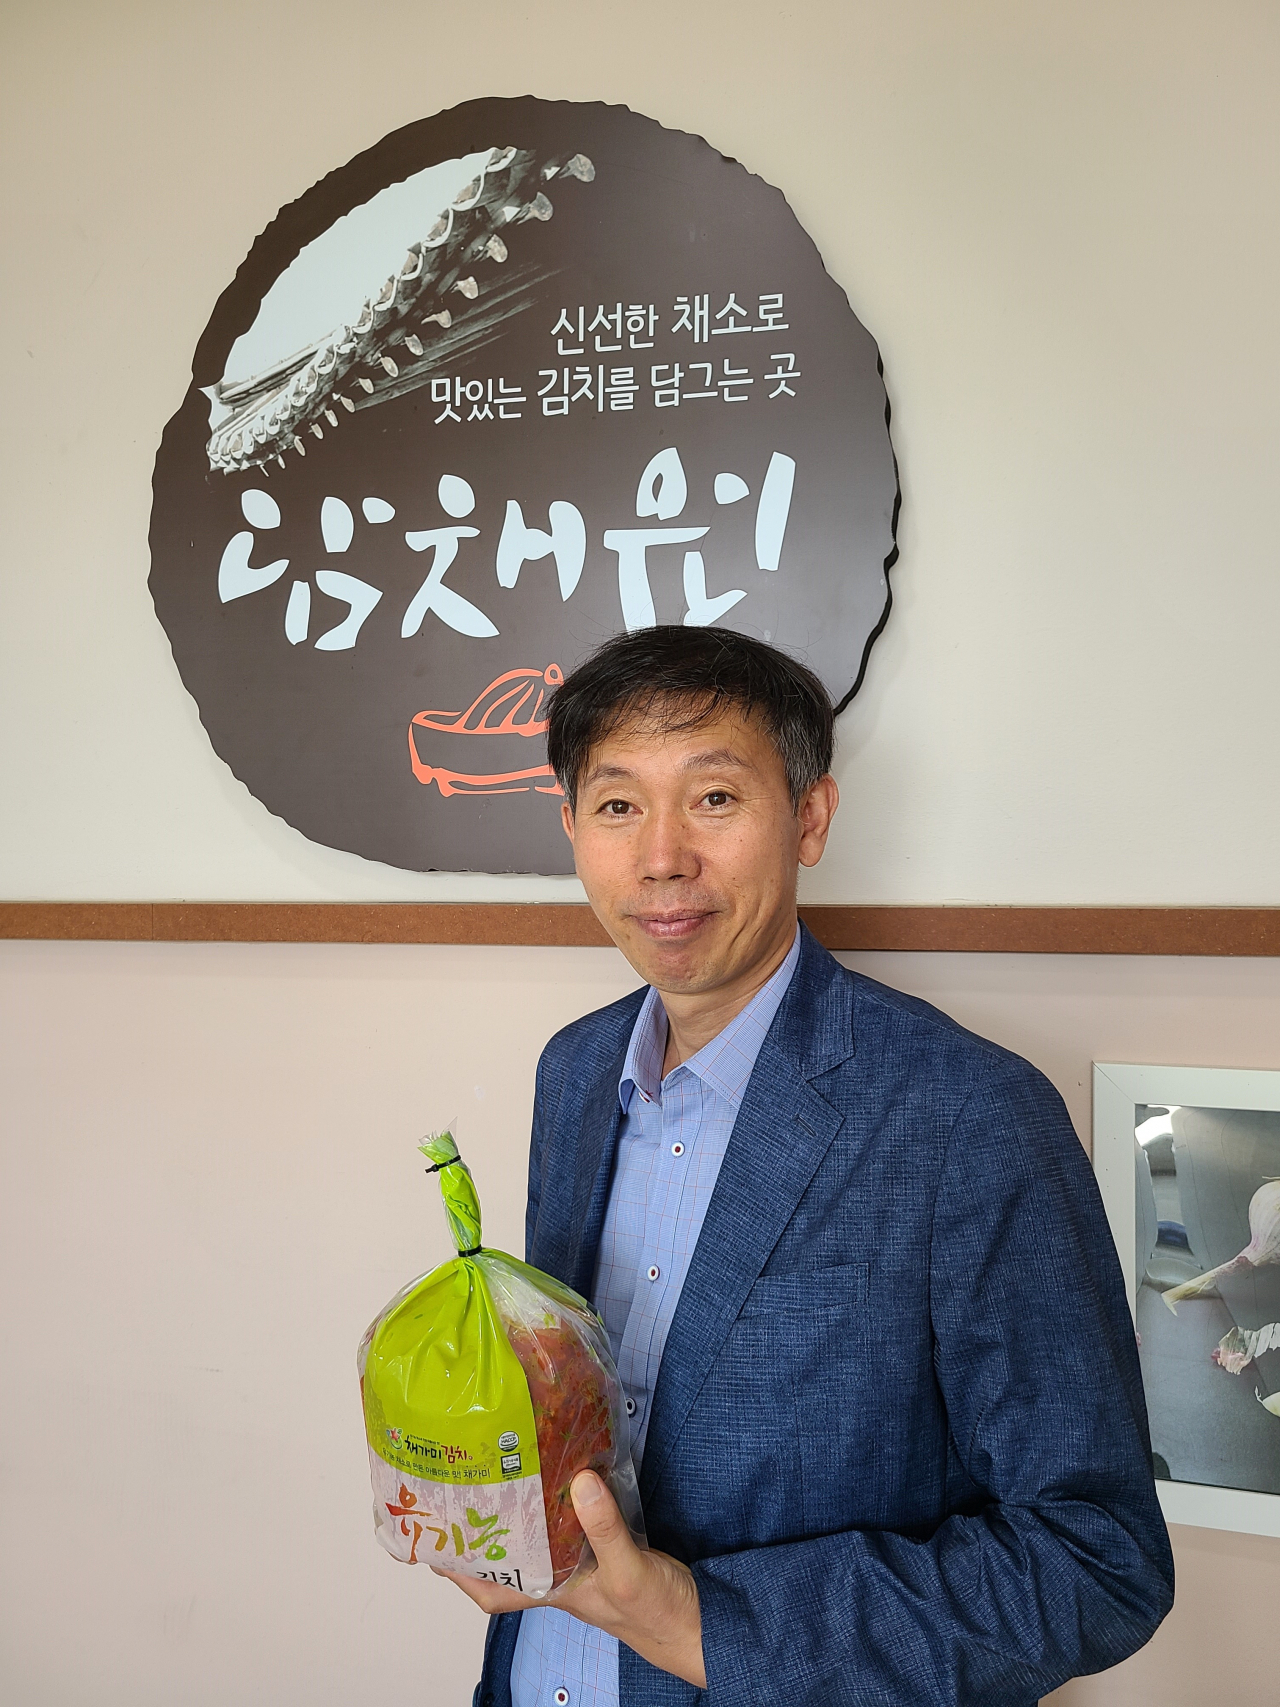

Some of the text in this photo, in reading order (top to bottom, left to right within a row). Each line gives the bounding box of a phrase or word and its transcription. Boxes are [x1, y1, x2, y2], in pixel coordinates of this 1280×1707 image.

[550, 292, 790, 356] 신선한 채소로
[430, 352, 802, 425] 맛있는 김치를 담그는 곳
[218, 447, 796, 651] 담채원
[425, 1466, 450, 1478] 아름다운
[463, 1468, 490, 1479] 채가미
[385, 1482, 511, 1563] 유기농
